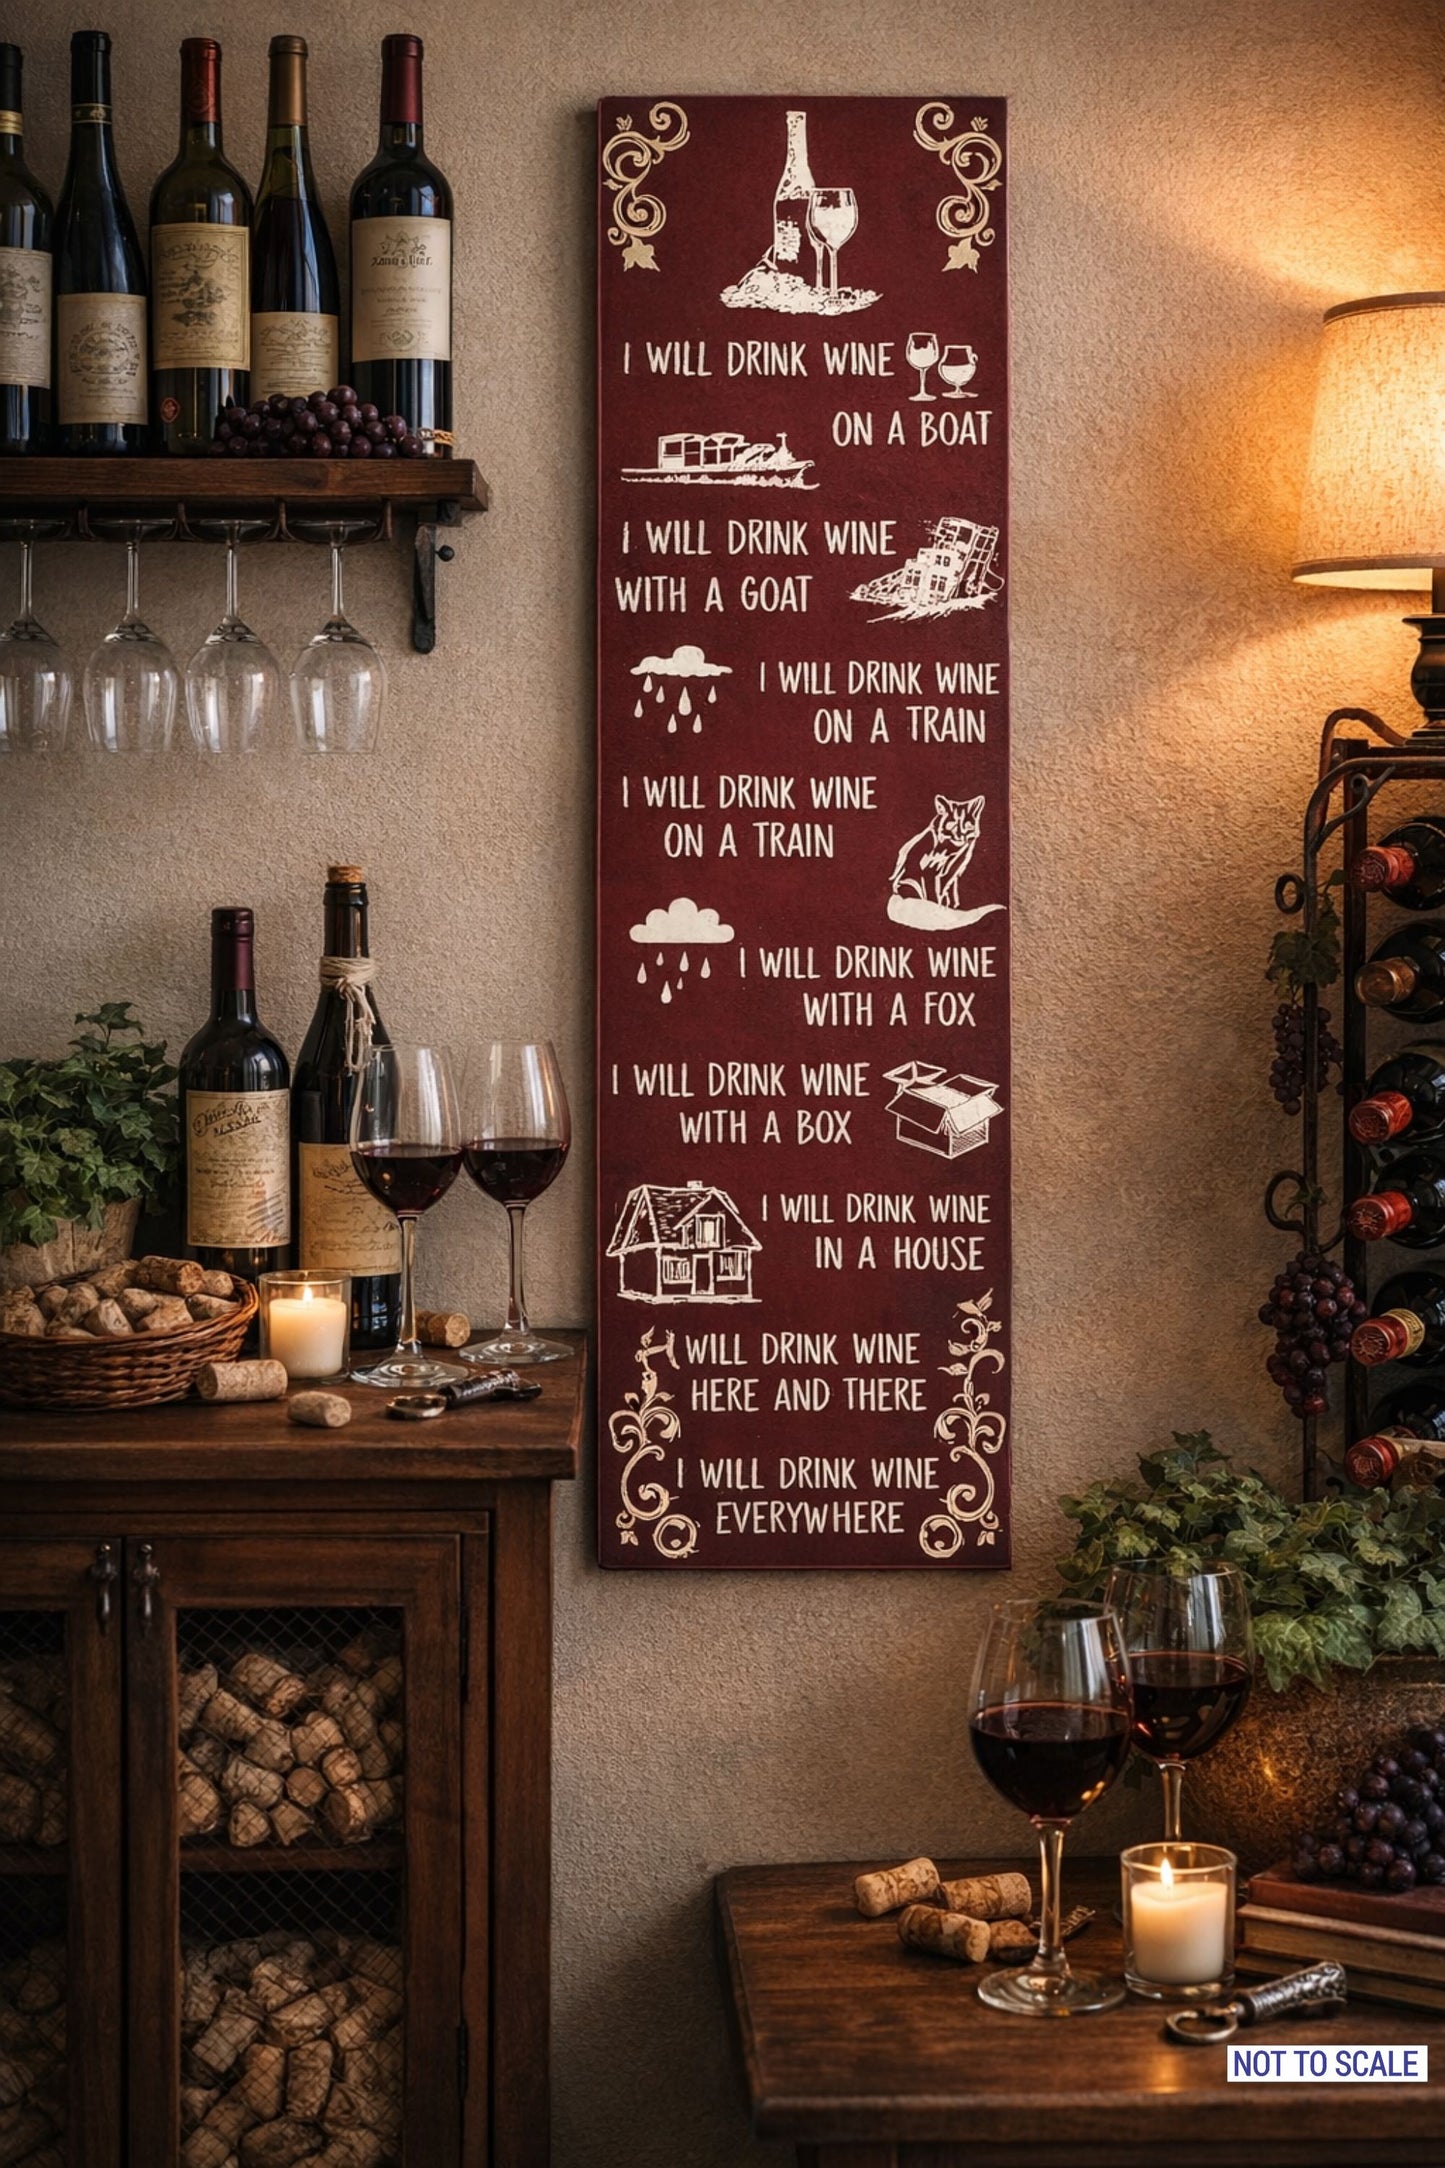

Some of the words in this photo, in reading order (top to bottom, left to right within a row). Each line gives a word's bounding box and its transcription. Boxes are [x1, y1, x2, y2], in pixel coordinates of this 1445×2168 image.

[623, 342, 631, 375] I
[646, 340, 713, 377] WILL
[727, 340, 808, 377] DRINK
[823, 341, 895, 377] WINE
[832, 411, 873, 447] ON
[887, 410, 906, 446] A
[919, 410, 993, 448] BOAT
[621, 521, 631, 554] I
[645, 519, 712, 556] WILL
[728, 518, 809, 556] DRINK
[823, 520, 897, 556] WINE
[614, 575, 687, 613] WITH
[704, 576, 724, 613] A
[740, 575, 813, 613] GOAT
[759, 661, 767, 692] I
[778, 661, 837, 695] WILL
[848, 660, 923, 695] DRINK
[935, 661, 1001, 695] WINE
[813, 708, 853, 745] ON
[870, 707, 890, 744] A
[905, 705, 986, 744] TRAIN
[621, 775, 630, 808] I
[643, 775, 706, 810] WILL
[719, 774, 796, 810] DRINK
[809, 775, 878, 810] WINE
[664, 822, 703, 858] ON
[718, 822, 738, 858] A
[752, 821, 834, 859] TRAIN
[738, 947, 747, 978] I
[759, 946, 821, 980] WILL
[835, 944, 914, 979] DRINK
[927, 946, 997, 978] WINE
[803, 991, 873, 1027] WITH
[889, 992, 908, 1026] A
[924, 991, 976, 1027] FOX
[611, 1064, 620, 1095] I
[633, 1062, 695, 1098] WILL
[708, 1061, 787, 1097] DRINK
[800, 1062, 870, 1097] WINE
[679, 1109, 747, 1144] WITH
[762, 1110, 782, 1144] A
[796, 1109, 852, 1145] BOX
[761, 1194, 769, 1222] I
[780, 1193, 835, 1224] WILL
[846, 1192, 917, 1224] DRINK
[928, 1194, 991, 1224] WINE
[815, 1236, 843, 1270] IN
[857, 1235, 877, 1270] A
[894, 1236, 985, 1271] HOUSE
[685, 1333, 748, 1366] WILL
[762, 1331, 839, 1365] DRINK
[852, 1332, 921, 1365] WINE
[691, 1377, 760, 1413] HERE
[774, 1377, 831, 1412] AND
[842, 1377, 927, 1412] THERE
[676, 1457, 685, 1489] I
[699, 1457, 765, 1491] WILL
[779, 1456, 858, 1490] DRINK
[871, 1457, 940, 1490] WINE
[716, 1500, 905, 1535] EVERYWHERE
